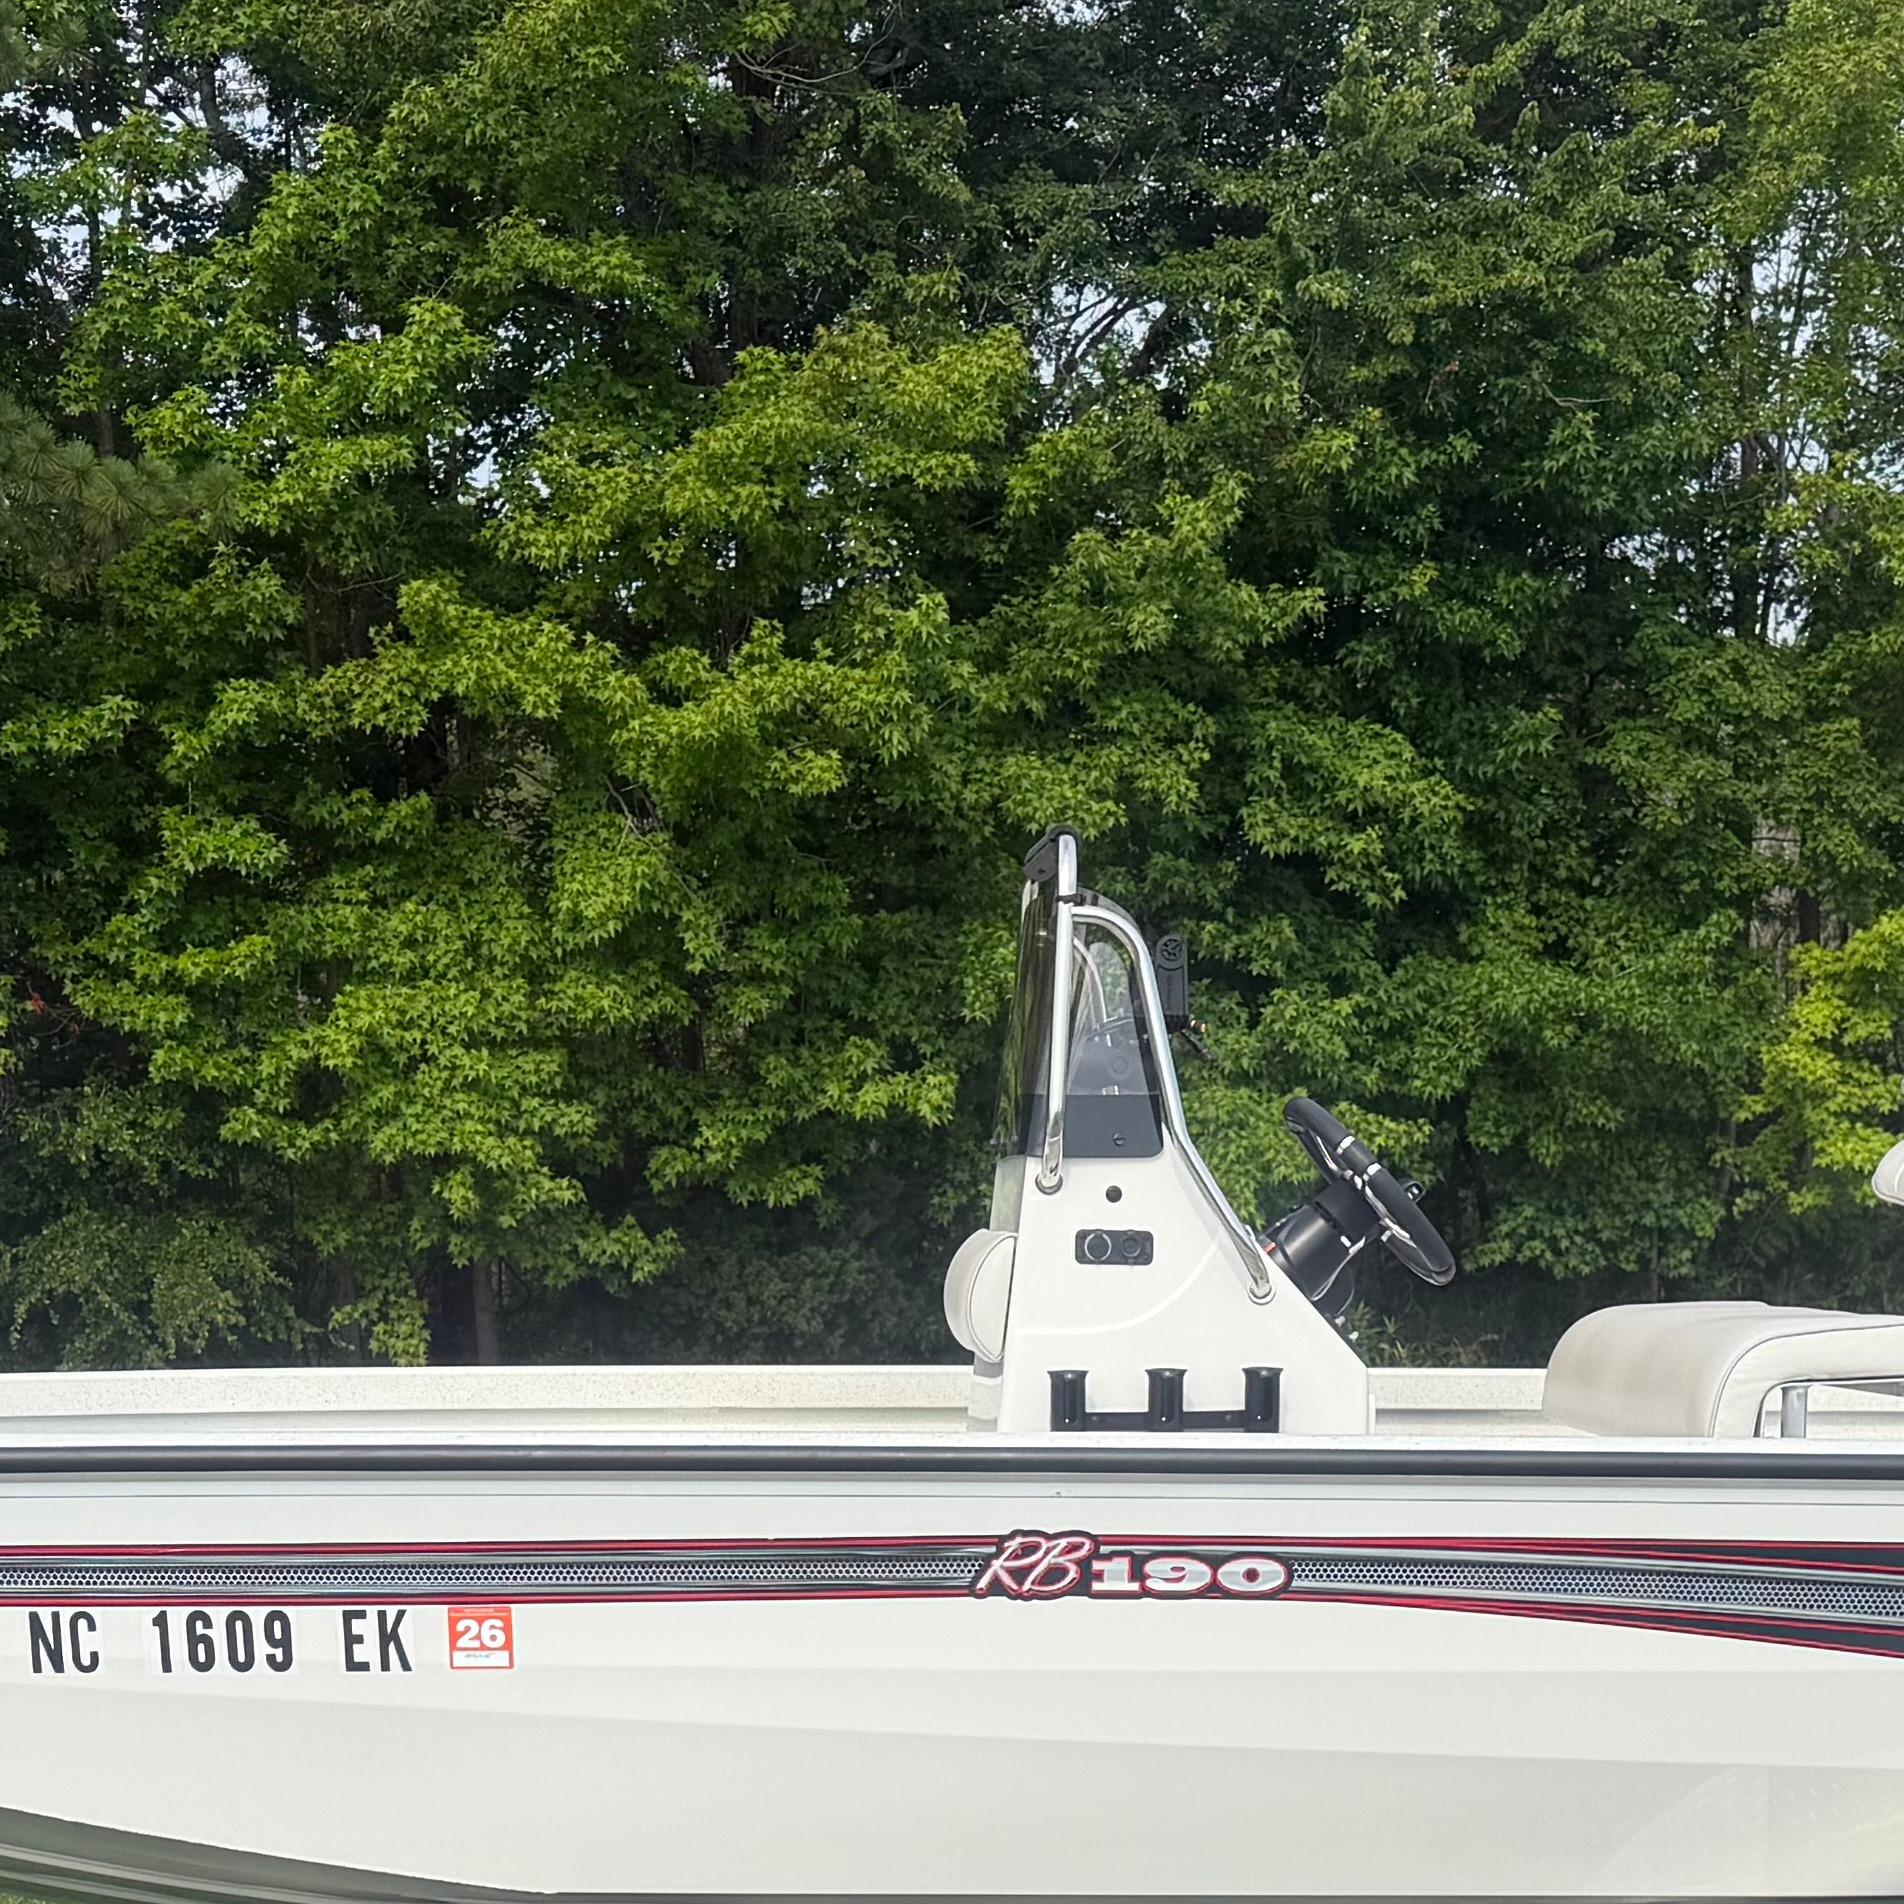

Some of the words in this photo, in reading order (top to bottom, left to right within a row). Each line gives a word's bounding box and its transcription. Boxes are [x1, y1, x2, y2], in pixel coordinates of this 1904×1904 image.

[28, 1610, 99, 1673] NC
[152, 1610, 293, 1673] 1609
[342, 1609, 412, 1672] EK
[455, 1618, 506, 1649] 26
